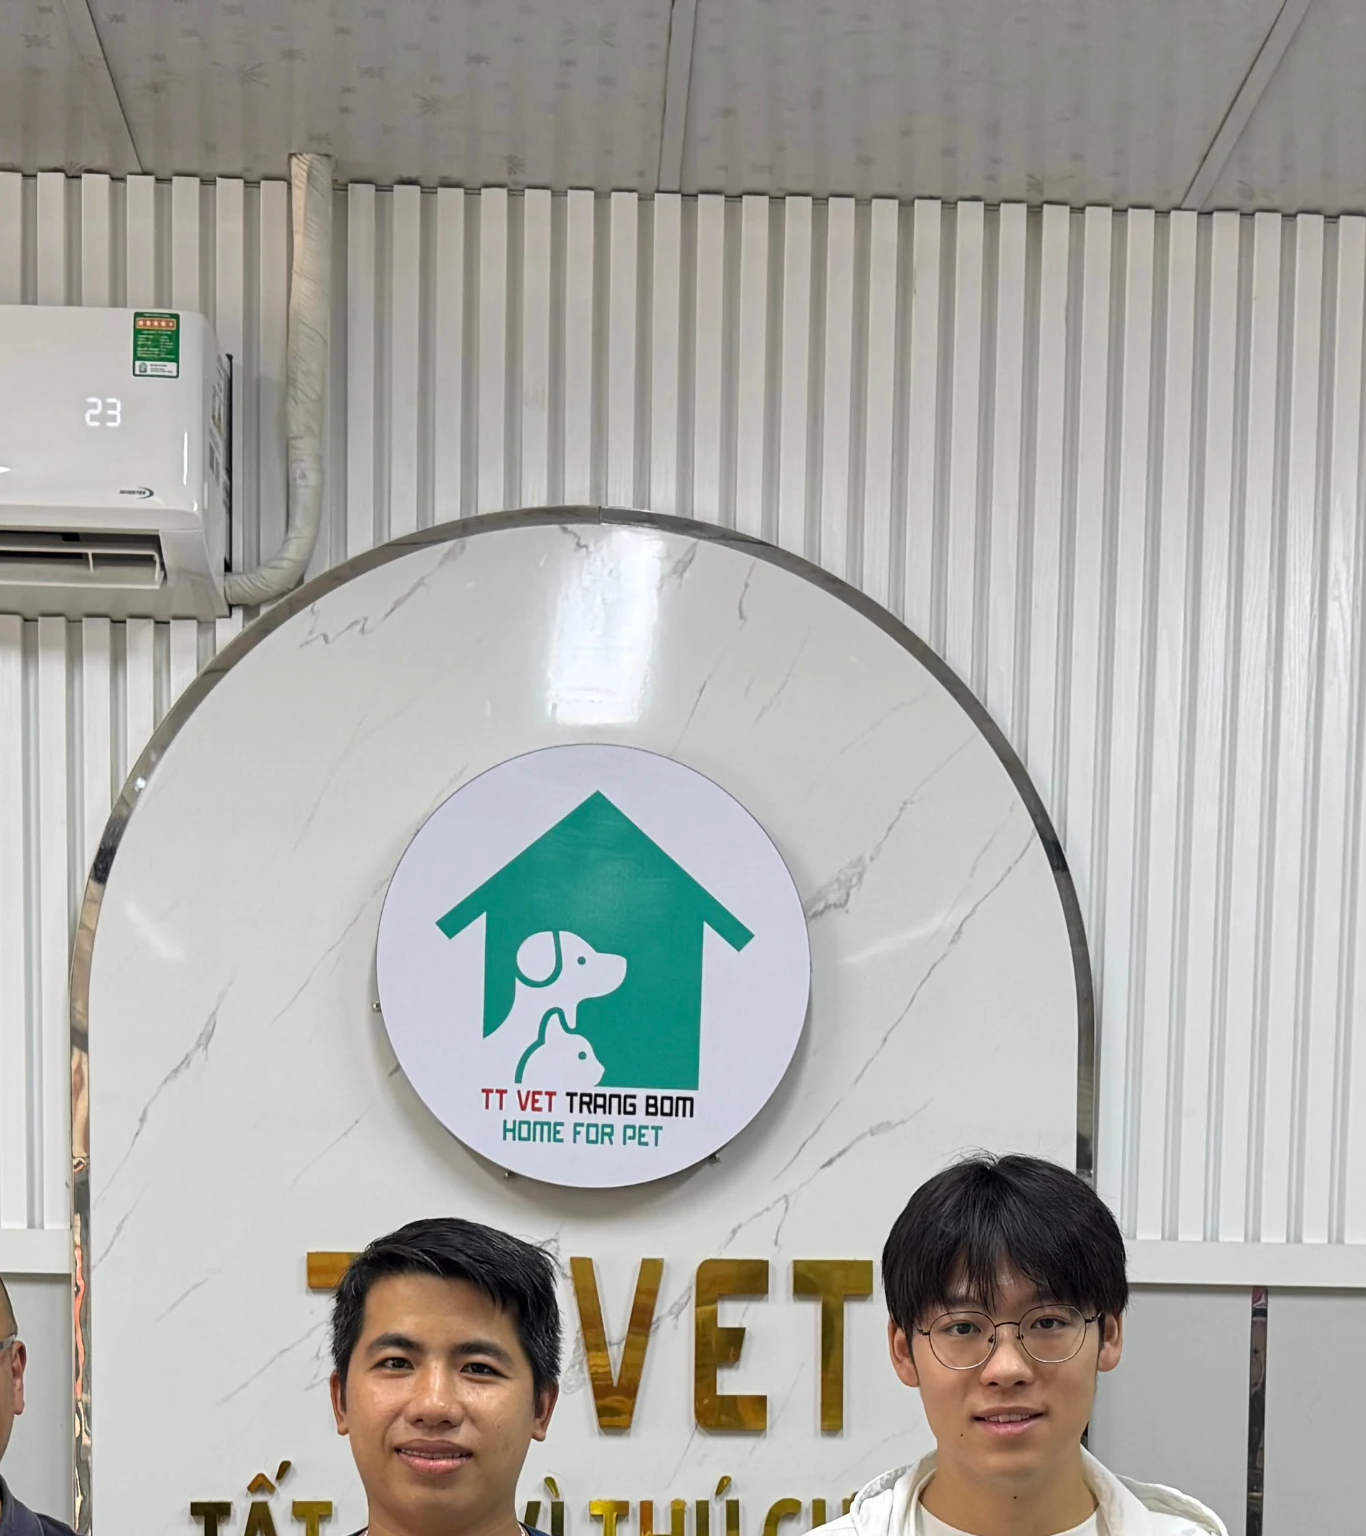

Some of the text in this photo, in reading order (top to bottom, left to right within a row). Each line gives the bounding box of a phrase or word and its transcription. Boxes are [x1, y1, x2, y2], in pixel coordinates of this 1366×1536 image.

[84, 396, 122, 428] 23
[481, 1088, 695, 1118] TT VET TRANG BOM
[503, 1119, 664, 1147] HOME FOR PET
[570, 1256, 873, 1431] VET
